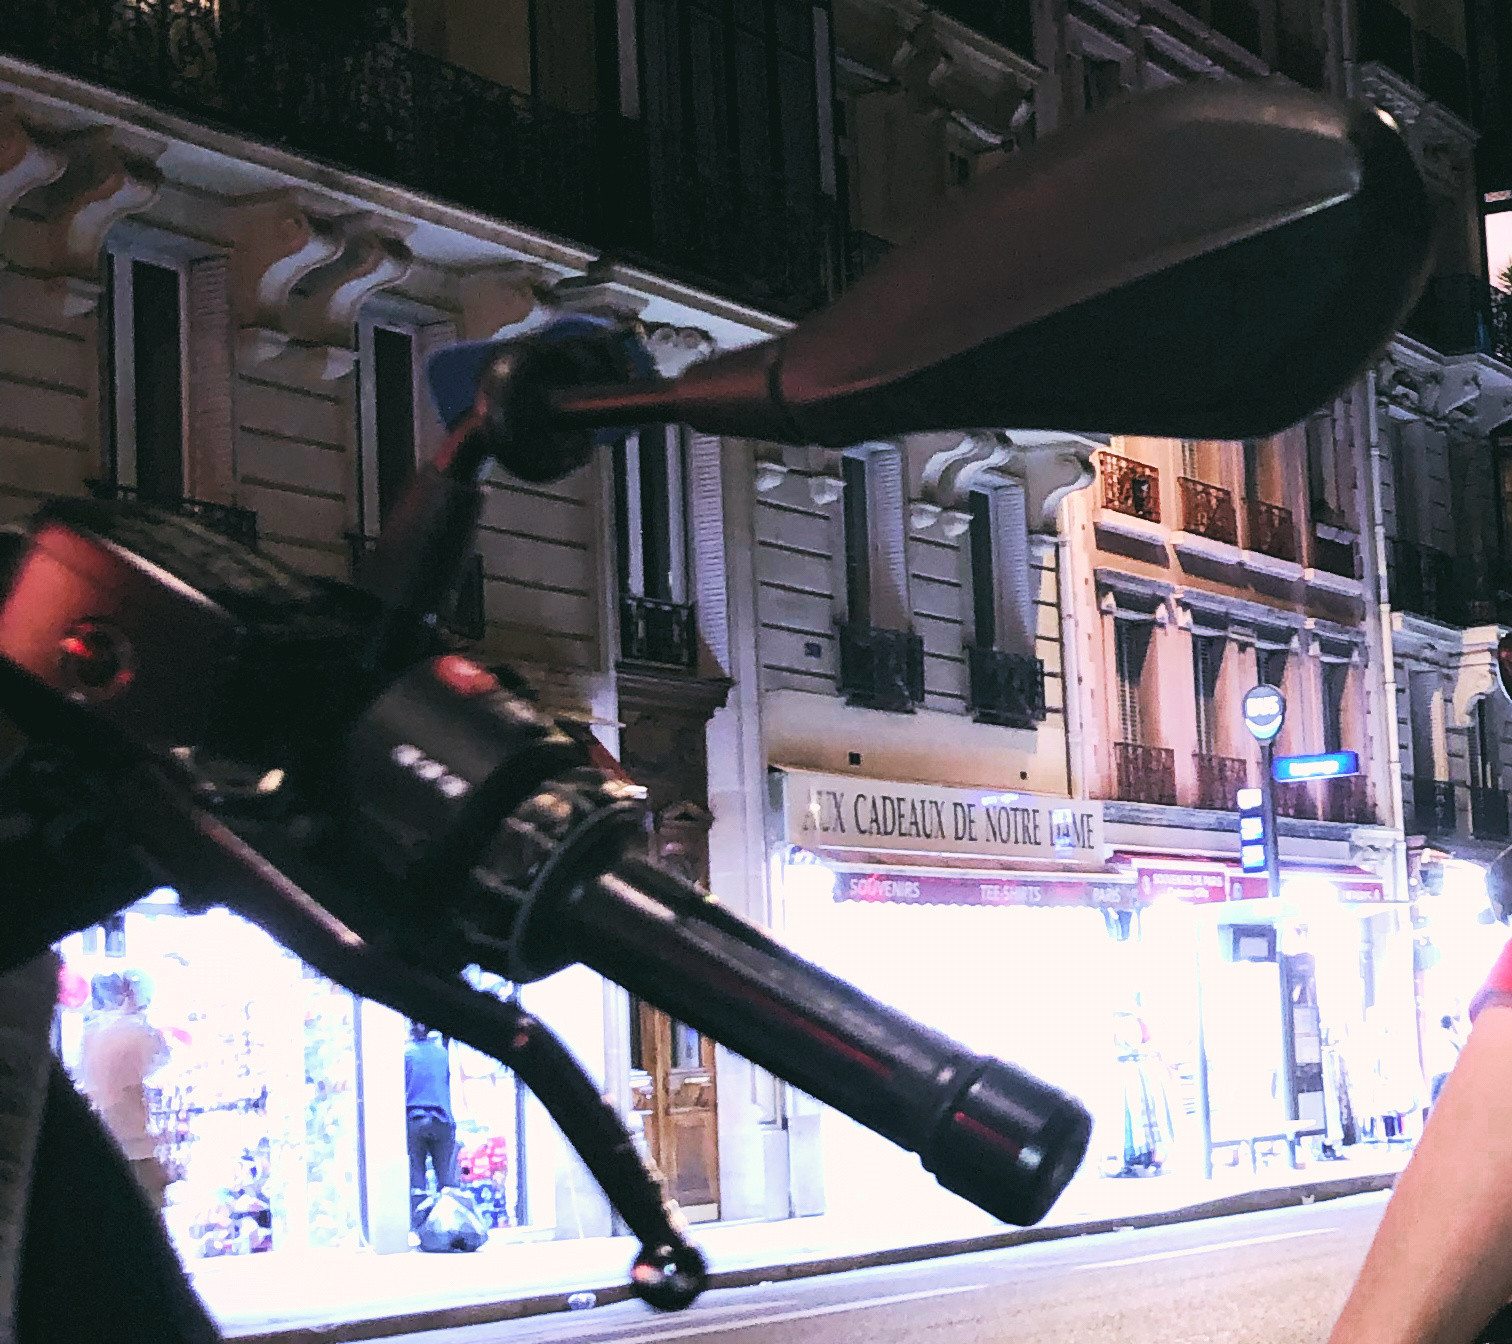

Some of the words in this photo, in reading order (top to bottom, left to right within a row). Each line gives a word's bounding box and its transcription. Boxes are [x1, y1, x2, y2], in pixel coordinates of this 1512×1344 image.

[853, 793, 946, 840] CADEAUX
[953, 802, 976, 842] DE
[984, 806, 1042, 846] NOTRE
[850, 878, 921, 899] SOUVENIRS
